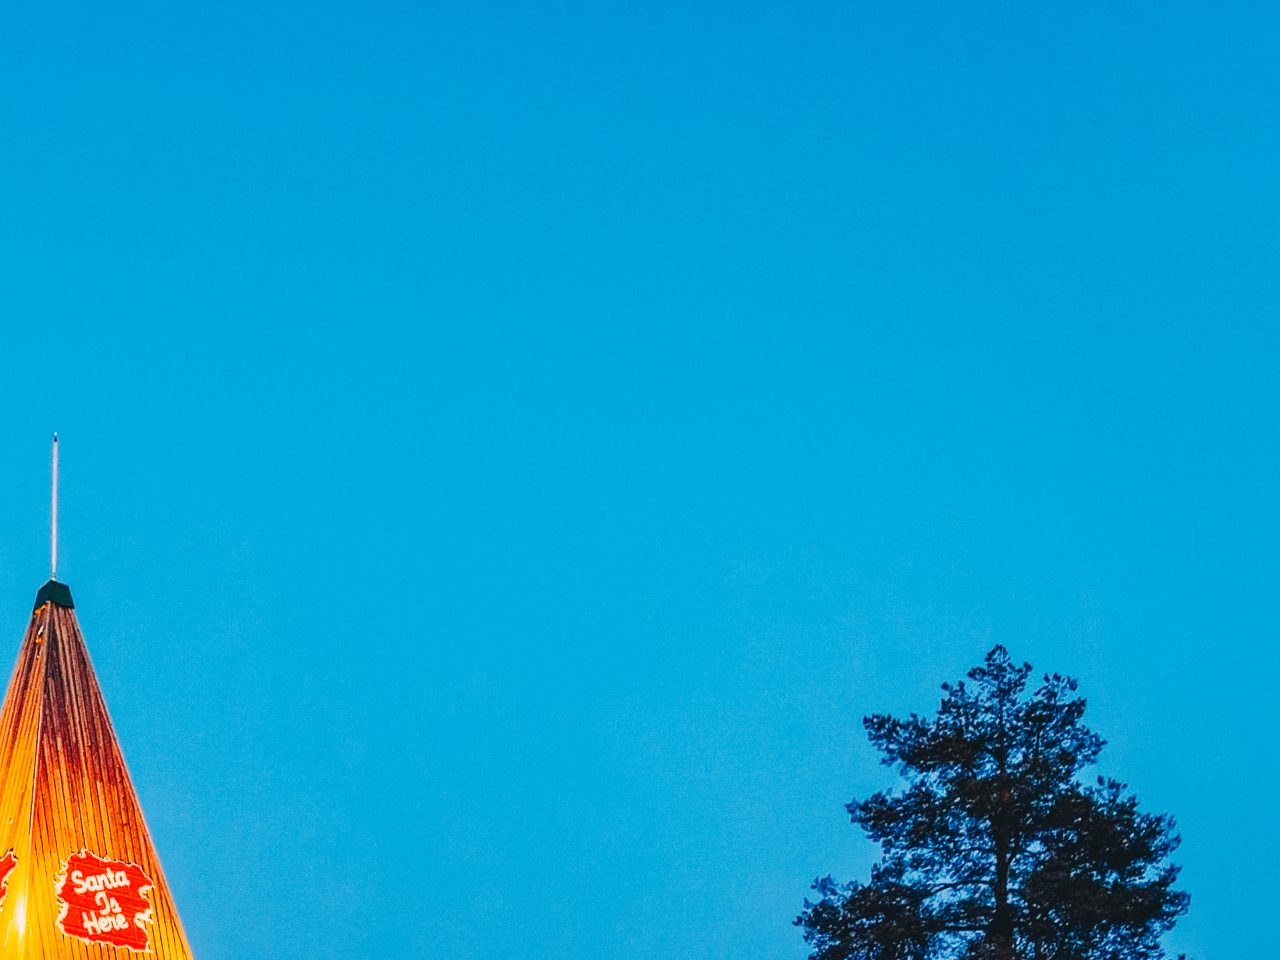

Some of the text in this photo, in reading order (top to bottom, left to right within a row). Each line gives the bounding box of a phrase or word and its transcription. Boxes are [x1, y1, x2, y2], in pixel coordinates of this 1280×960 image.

[71, 867, 130, 894] Santa
[95, 891, 122, 915] Is
[82, 910, 129, 935] Here
